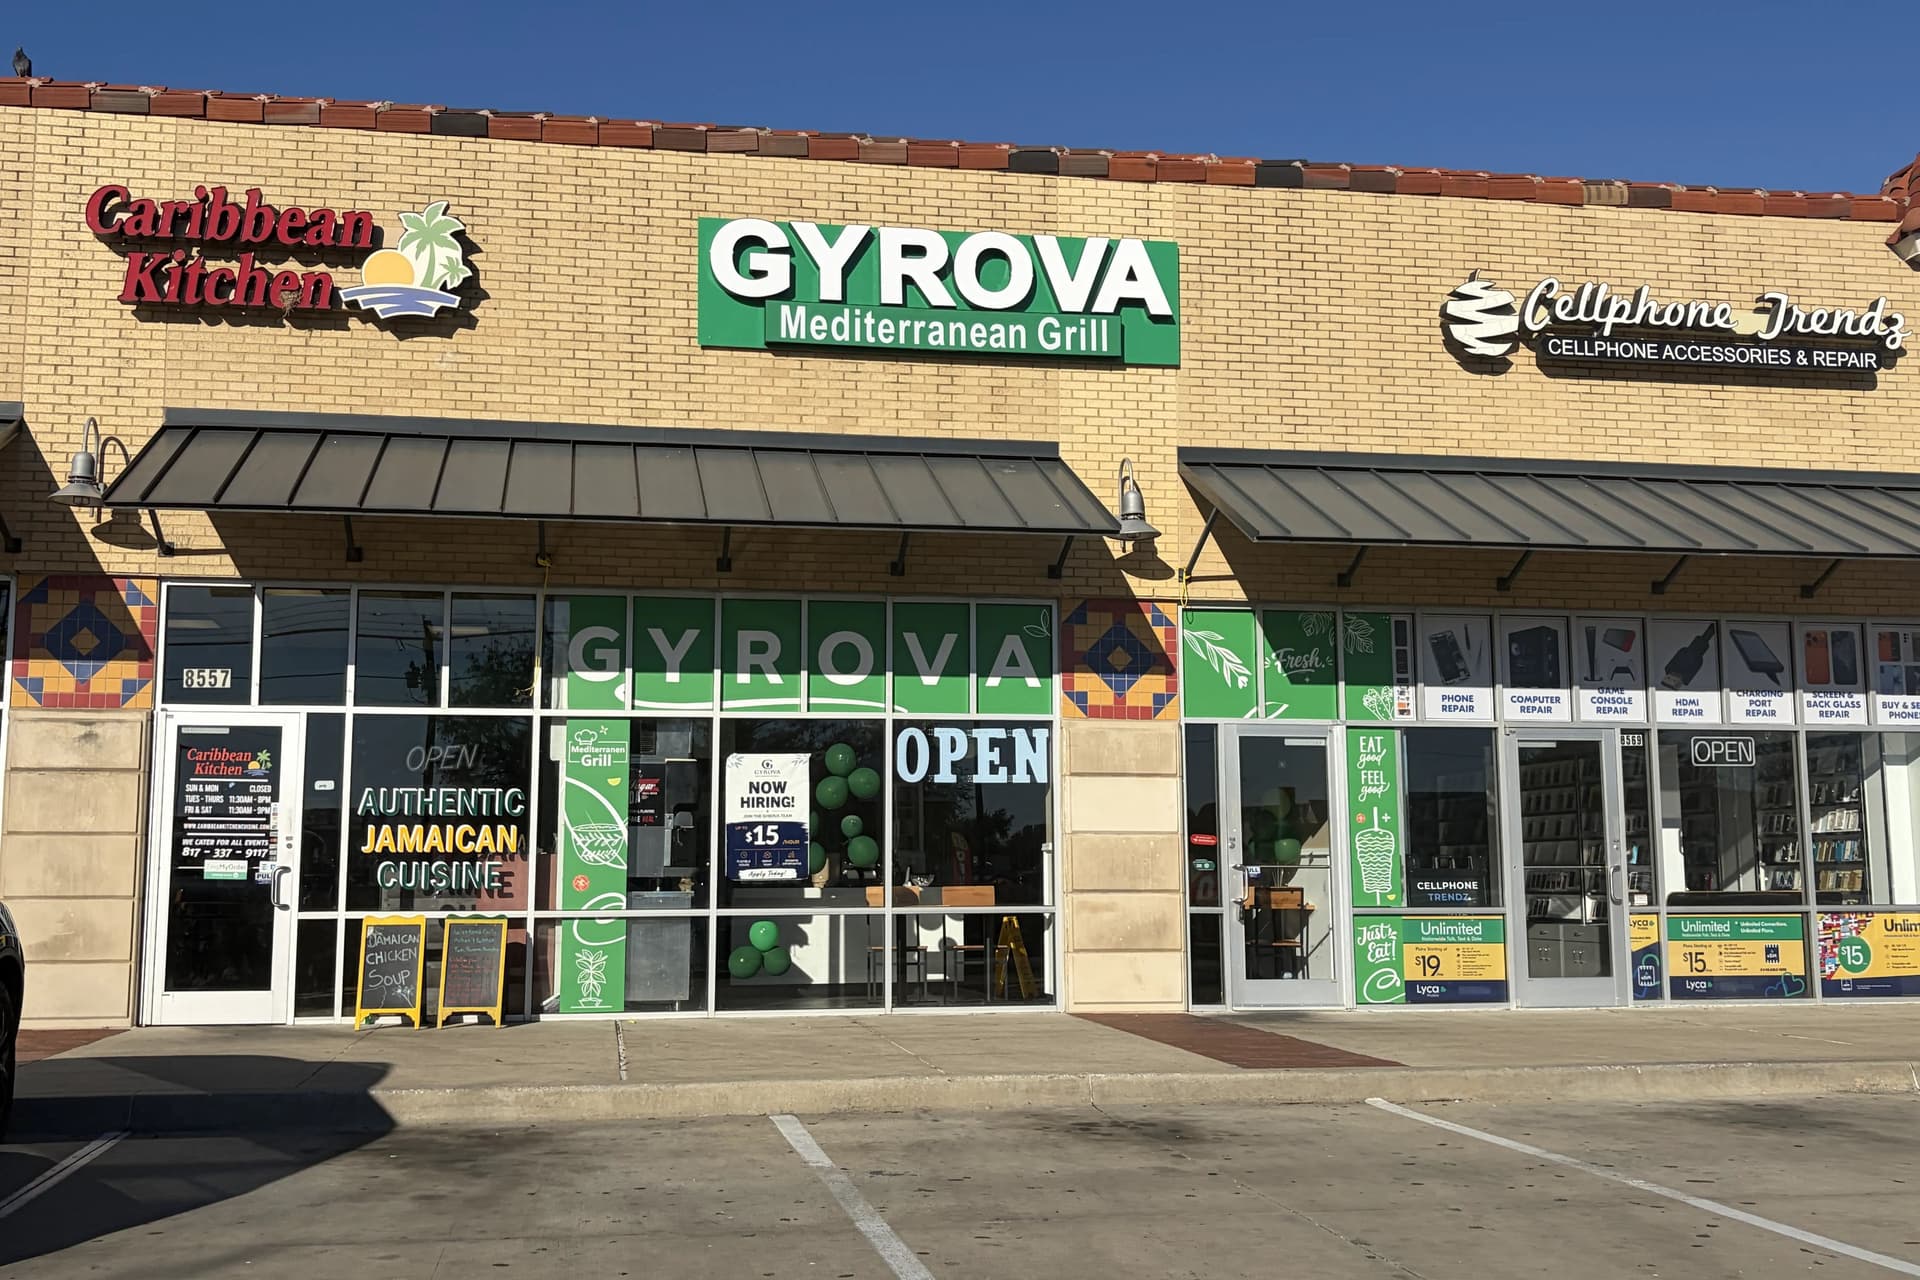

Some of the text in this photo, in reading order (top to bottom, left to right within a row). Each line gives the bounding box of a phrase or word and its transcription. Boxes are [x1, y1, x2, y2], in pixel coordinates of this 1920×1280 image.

[85, 184, 374, 249] Caribbean
[709, 218, 1173, 316] GYROVA
[118, 250, 333, 311] Kitchen
[1524, 277, 1912, 350] Cellphone Trendz
[780, 304, 1108, 352] Mediterranean Grill
[1548, 338, 1877, 369] CELLPHONE ACCESSORIES & REPAIR
[568, 625, 1042, 687] GYROVA
[185, 669, 230, 687] 8557
[1597, 687, 1625, 695] GAME
[1736, 690, 1784, 698] CHARGING
[1812, 690, 1844, 699] SCREEN
[1441, 694, 1474, 703] PHONE
[1510, 695, 1561, 704] COMPUTER
[1590, 696, 1633, 705] CONSOLE
[1675, 698, 1699, 707] HDMI
[1749, 699, 1772, 708] PORT
[1806, 700, 1861, 709] BACK GLASS
[1441, 704, 1475, 713] REPAIR
[1519, 705, 1553, 714] REPAIR
[1596, 706, 1628, 715] REPAIR
[1881, 701, 1900, 710] BUY
[1902, 701, 1909, 710] &
[1672, 708, 1704, 717] REPAIR
[1745, 708, 1777, 718] REPAIR
[1818, 709, 1850, 719] REPAIR
[1359, 736, 1384, 753] EAT
[1620, 735, 1642, 746] 8569
[187, 748, 252, 762] Caribbean
[571, 745, 626, 754] Mediterranen
[896, 725, 1050, 784] OPEN
[1694, 740, 1753, 763] OPEN
[406, 743, 479, 772] OPEN
[581, 754, 612, 767] Grill
[1356, 749, 1387, 768] good
[194, 762, 243, 776] Kitchen
[1361, 770, 1387, 785] FEEL
[185, 784, 219, 792] SUN & MON
[249, 785, 272, 793] CLOSED
[749, 781, 787, 794] NOW
[1358, 782, 1391, 802] good
[185, 795, 200, 803] TUES
[205, 795, 224, 803] THURS
[357, 787, 526, 817] AUTHENTIC
[740, 796, 795, 809] HIRING!
[184, 806, 213, 814] FRI & SAT
[361, 824, 519, 854] JAMAICAN
[745, 825, 779, 846] $15
[182, 847, 201, 857] 817
[213, 849, 232, 858] 337
[245, 849, 269, 858] 9117
[377, 861, 503, 890] CUISINE
[1416, 881, 1478, 890] CELLPHONE
[1428, 893, 1470, 901] TRENDZ
[1420, 921, 1482, 935] Unlimited
[1681, 920, 1731, 932] Unlimited
[1357, 922, 1391, 946] Just
[367, 933, 421, 949] JAMAICAN
[366, 947, 418, 966] CHICKEN
[1367, 940, 1397, 964] Eat!
[1841, 945, 1864, 966] $15
[1415, 955, 1441, 977] $19
[1683, 951, 1707, 973] $15
[368, 968, 411, 988] SOUP
[1416, 984, 1440, 995] Lyca
[1685, 980, 1706, 991] Lyca
